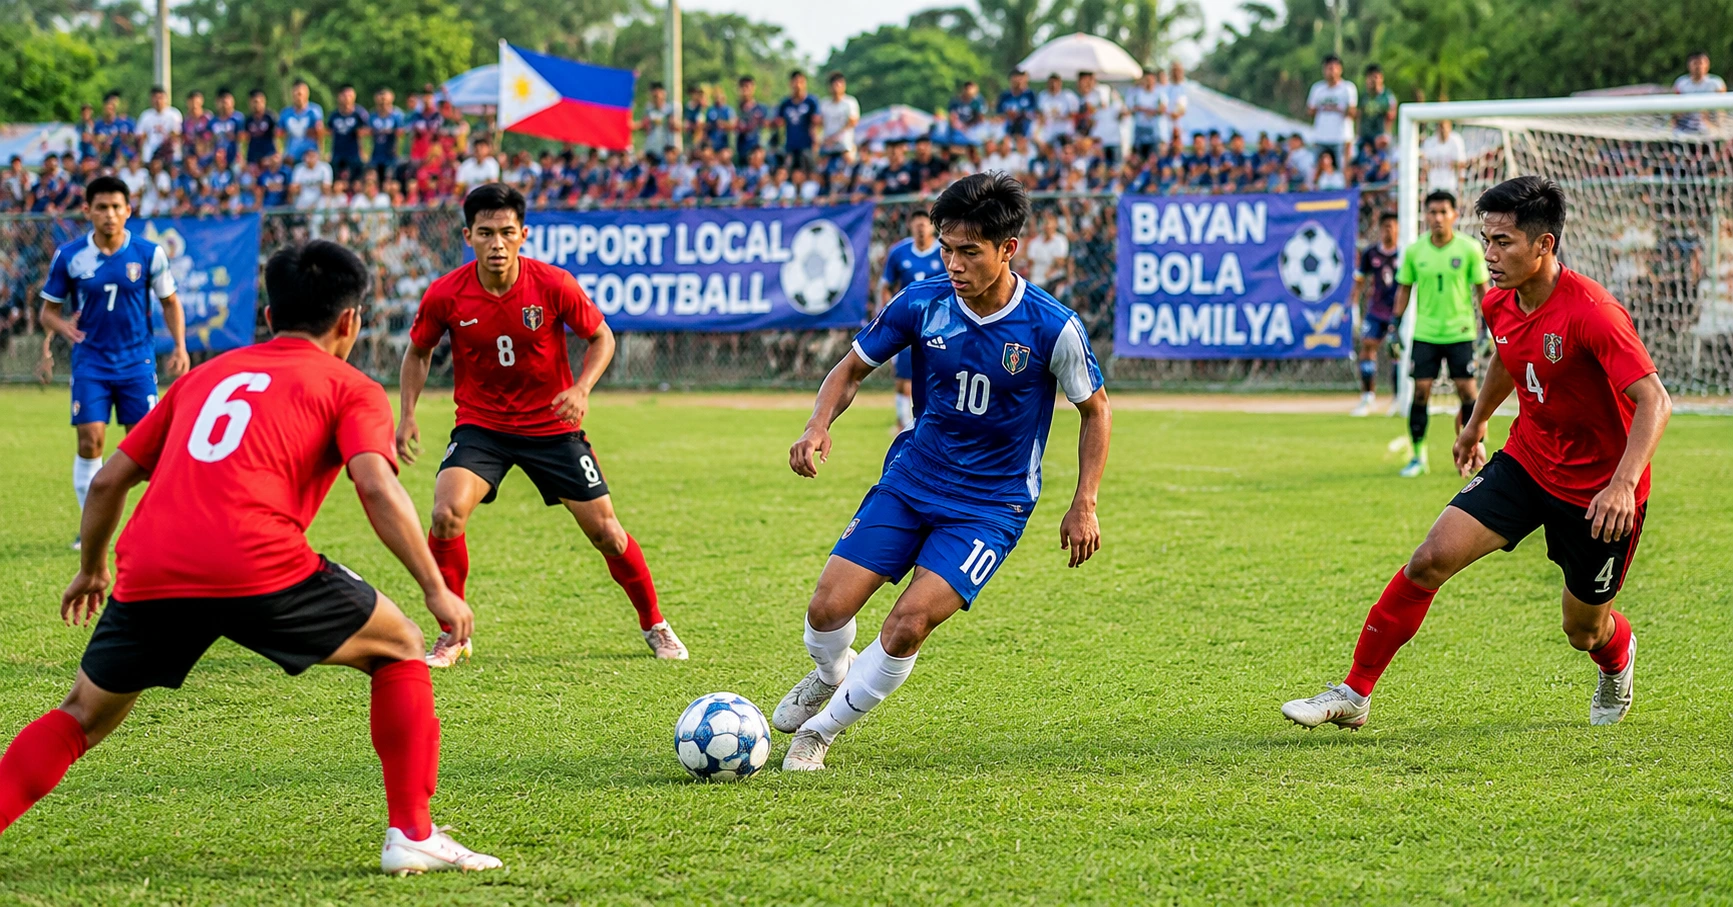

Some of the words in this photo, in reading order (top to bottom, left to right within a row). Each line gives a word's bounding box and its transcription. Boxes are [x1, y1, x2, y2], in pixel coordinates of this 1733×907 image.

[675, 220, 793, 265] LOCAL
[1131, 201, 1268, 245] BAYAN
[577, 271, 773, 316] FOOTBALL
[1132, 252, 1246, 295] BOLA
[1437, 274, 1444, 292] 1
[104, 283, 118, 312] 7
[1128, 303, 1295, 346] PAMILYA
[497, 335, 515, 367] 8
[956, 371, 990, 415] 10
[1526, 362, 1545, 404] 4
[187, 371, 272, 463] 6
[580, 455, 599, 483] 8
[959, 538, 997, 586] 10
[1594, 557, 1615, 590] 4
